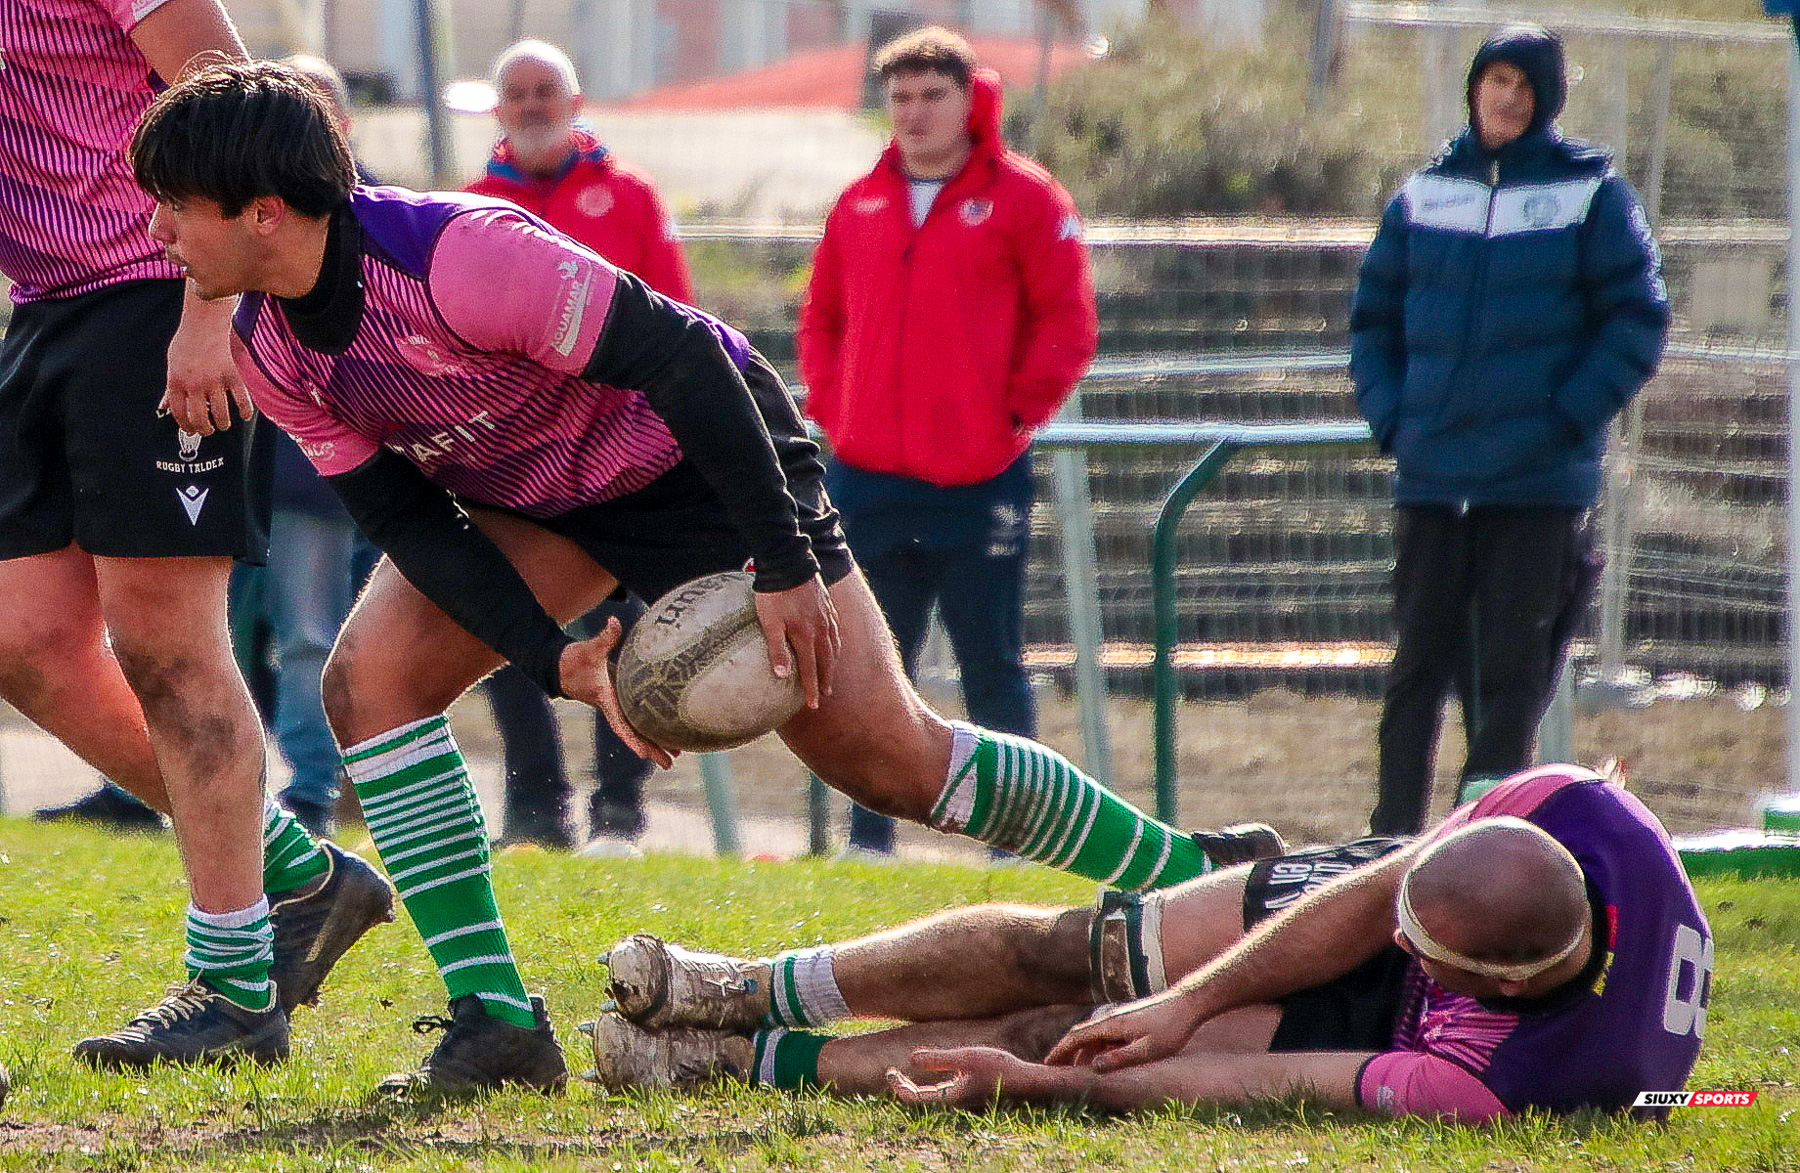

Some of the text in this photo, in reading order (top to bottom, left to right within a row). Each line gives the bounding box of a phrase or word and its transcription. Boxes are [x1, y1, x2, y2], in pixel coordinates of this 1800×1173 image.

[550, 280, 585, 350] AQUAMAR
[392, 410, 496, 463] AFIT
[156, 460, 186, 474] RUGBY
